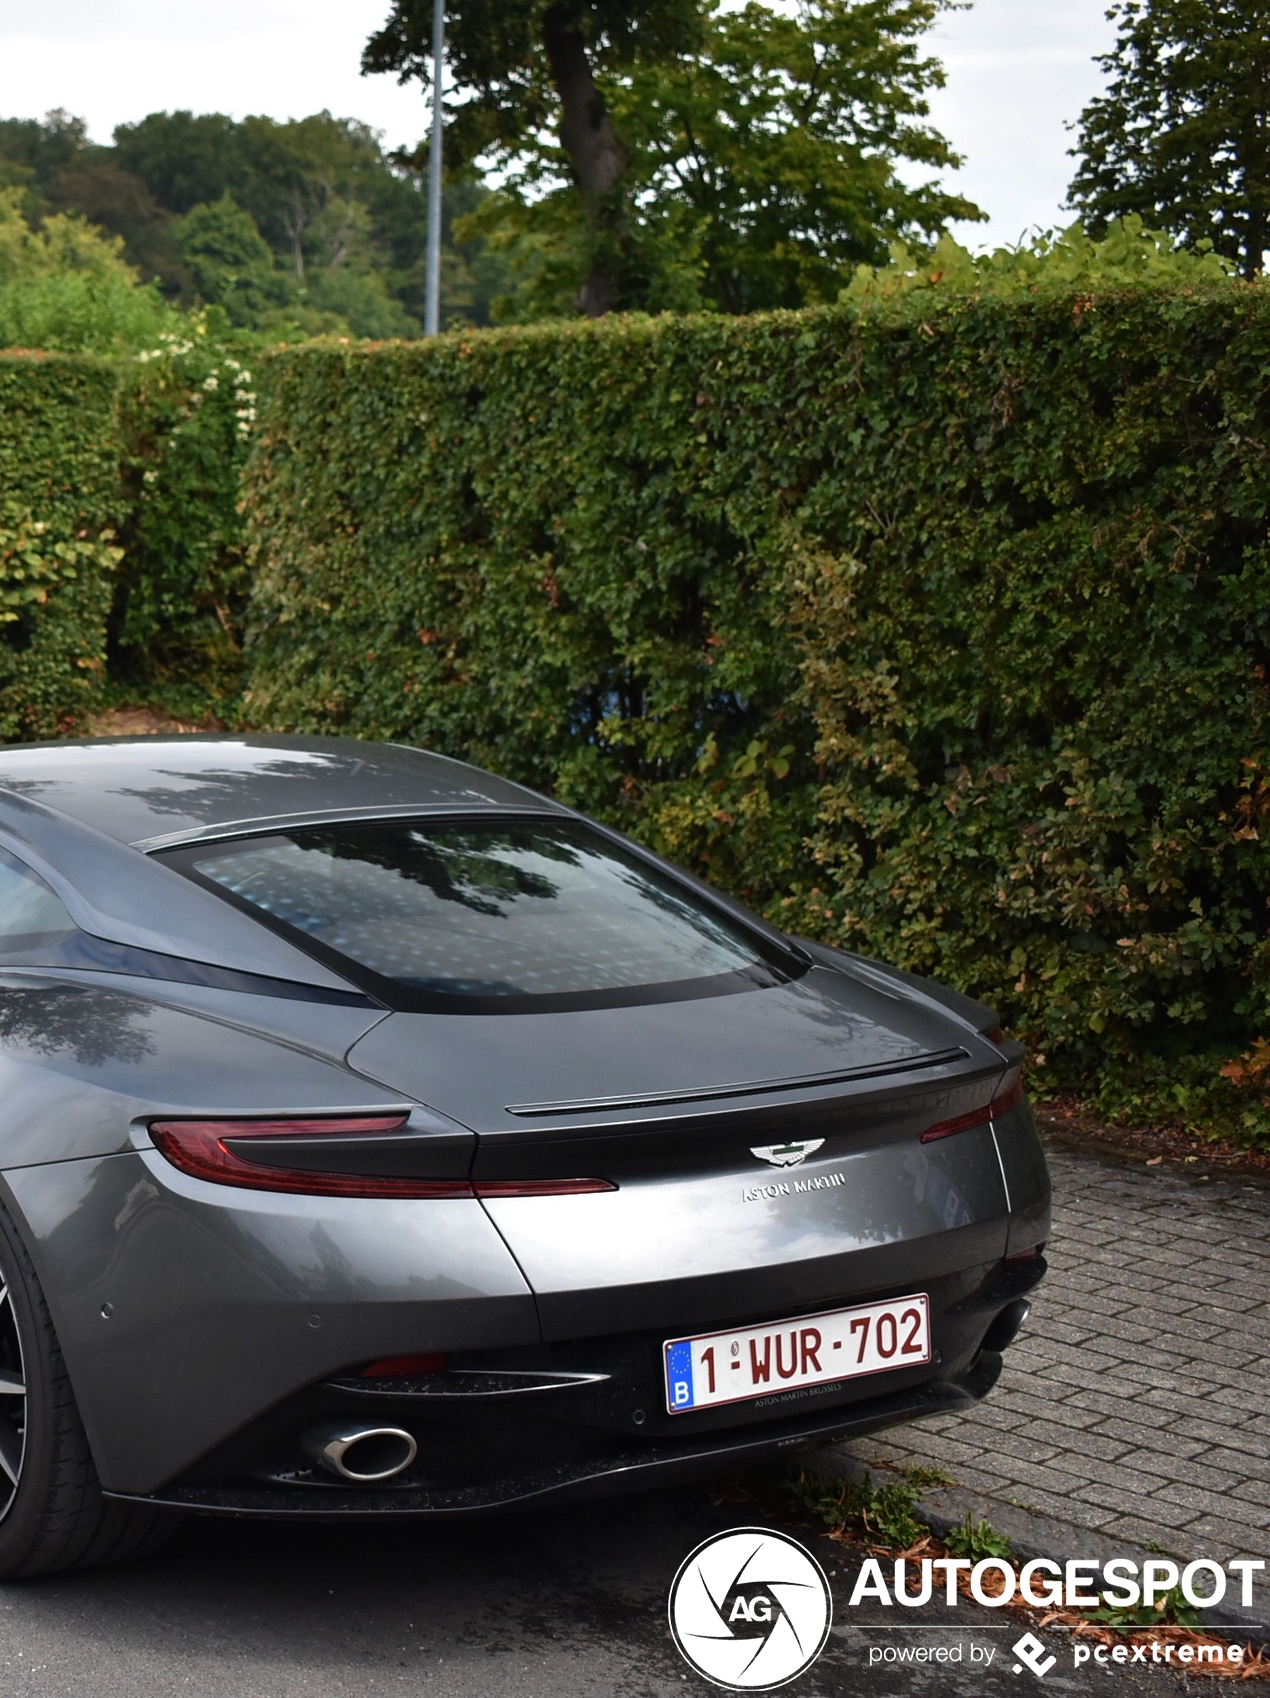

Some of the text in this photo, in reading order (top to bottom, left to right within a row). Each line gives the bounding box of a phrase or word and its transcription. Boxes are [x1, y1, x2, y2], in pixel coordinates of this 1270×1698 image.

[742, 1173, 846, 1202] ASTON MARTIN
[700, 1308, 923, 1394] 1-WUR-702
[674, 1381, 689, 1404] B
[754, 1383, 842, 1408] ASTON MARTIN BRUSSELS
